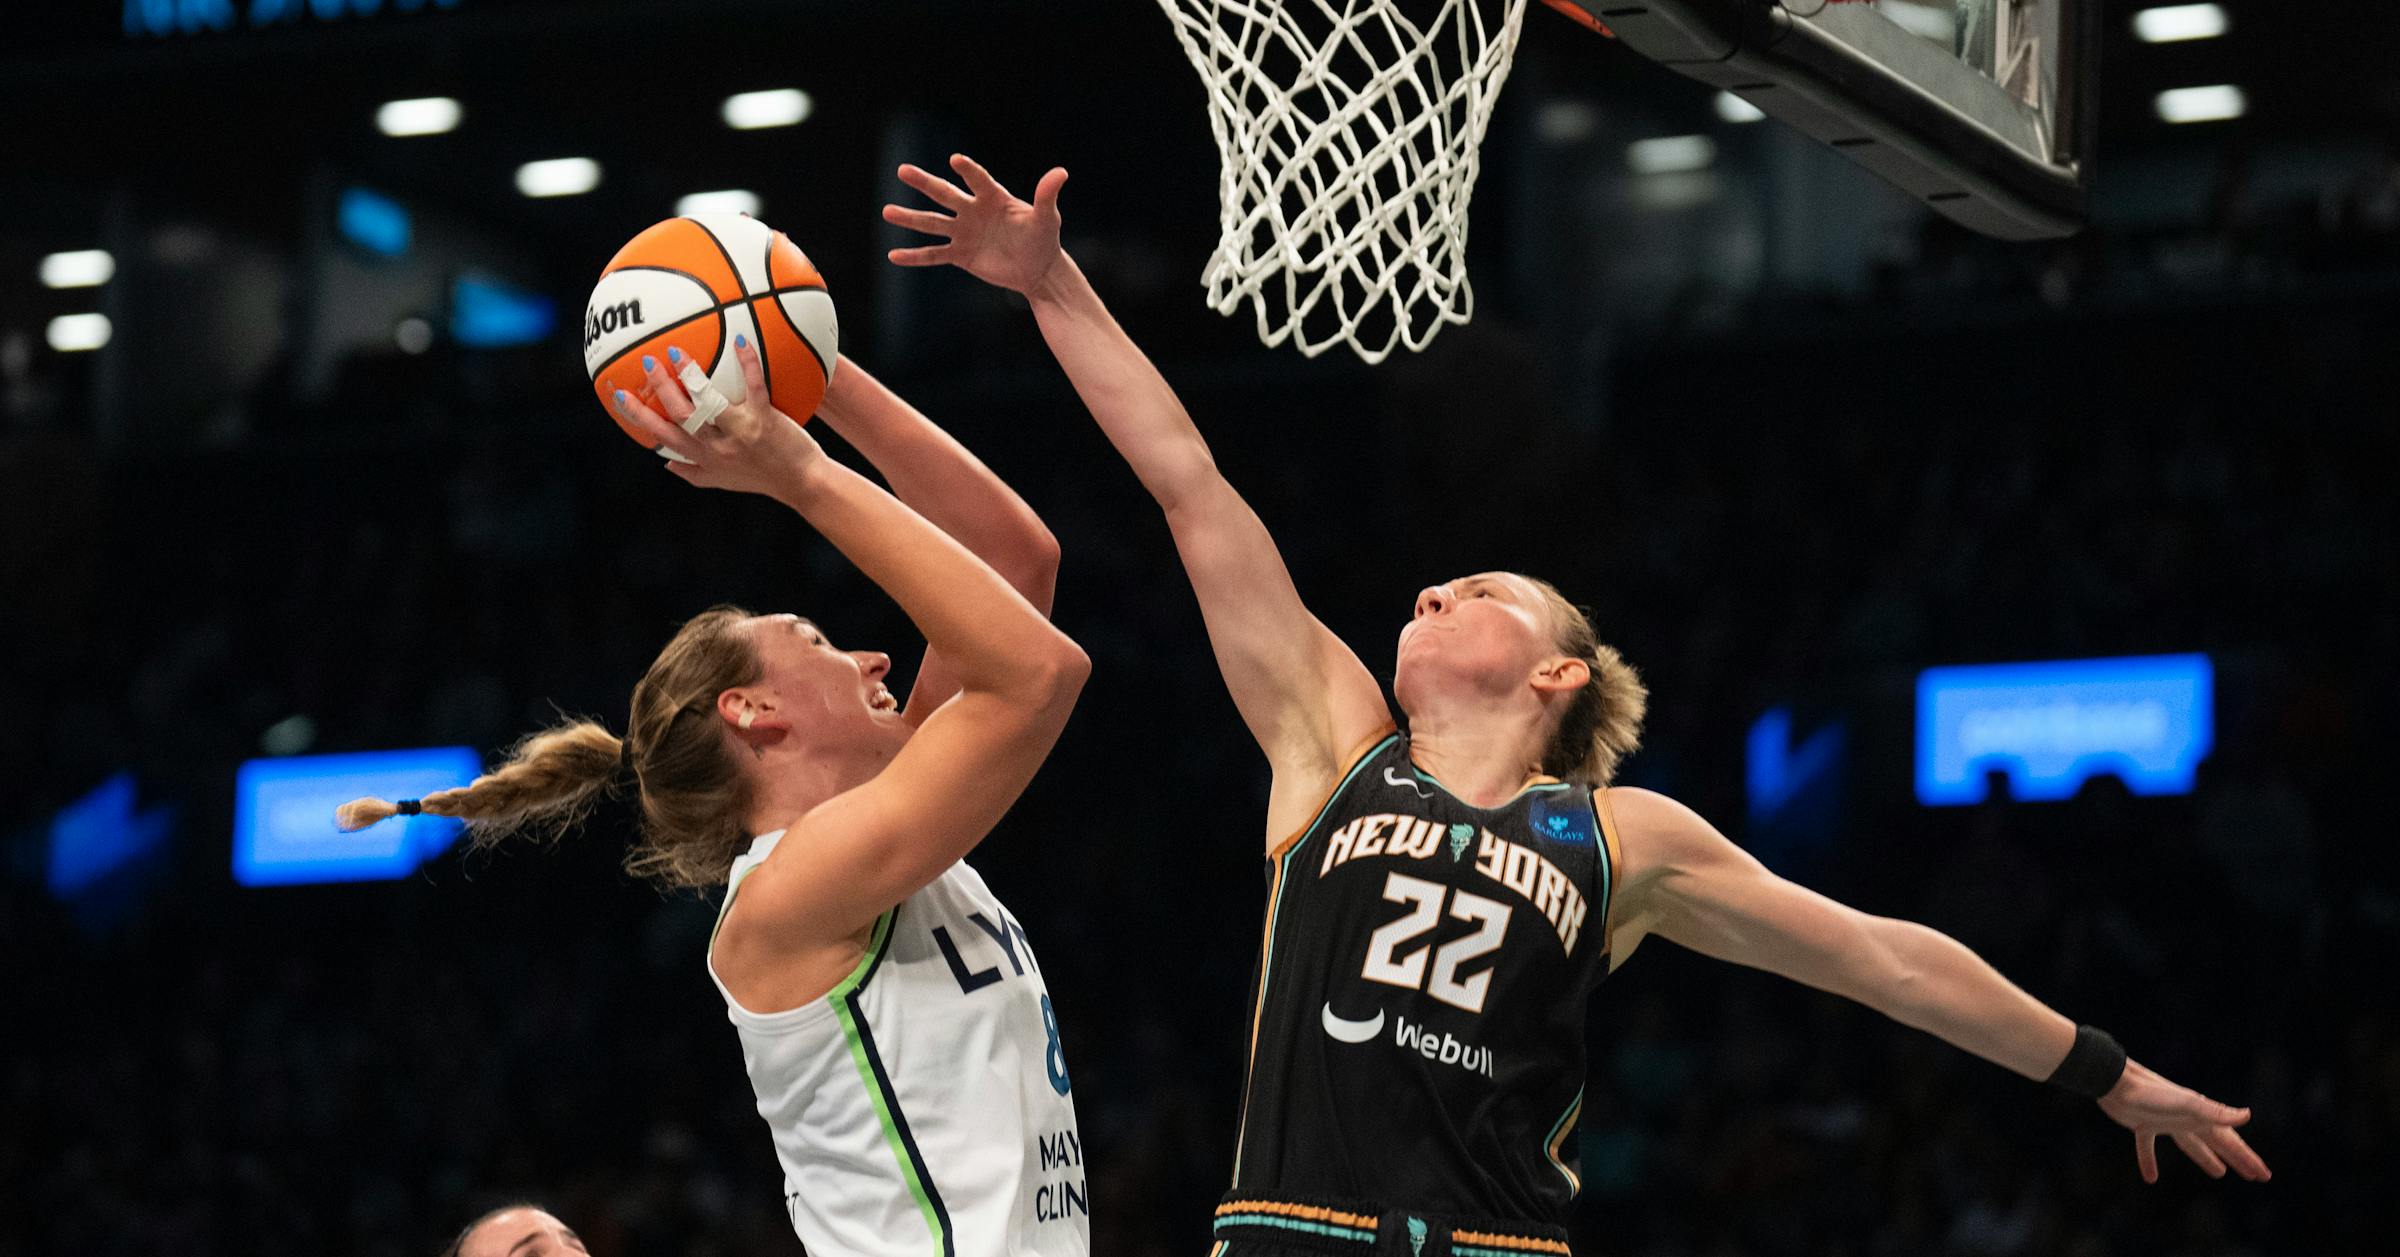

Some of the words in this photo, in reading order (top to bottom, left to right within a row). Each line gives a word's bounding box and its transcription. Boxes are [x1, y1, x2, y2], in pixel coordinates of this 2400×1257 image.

[1534, 819, 1585, 841] BARCLAYS
[1319, 813, 1447, 879] NEW
[1474, 825, 1588, 959] YORK
[1361, 870, 1513, 1014] 22
[1041, 993, 1072, 1097] 8
[1395, 1015, 1493, 1078] Webull
[1039, 1129, 1080, 1172] MAY
[1036, 1180, 1088, 1223] CLIN
